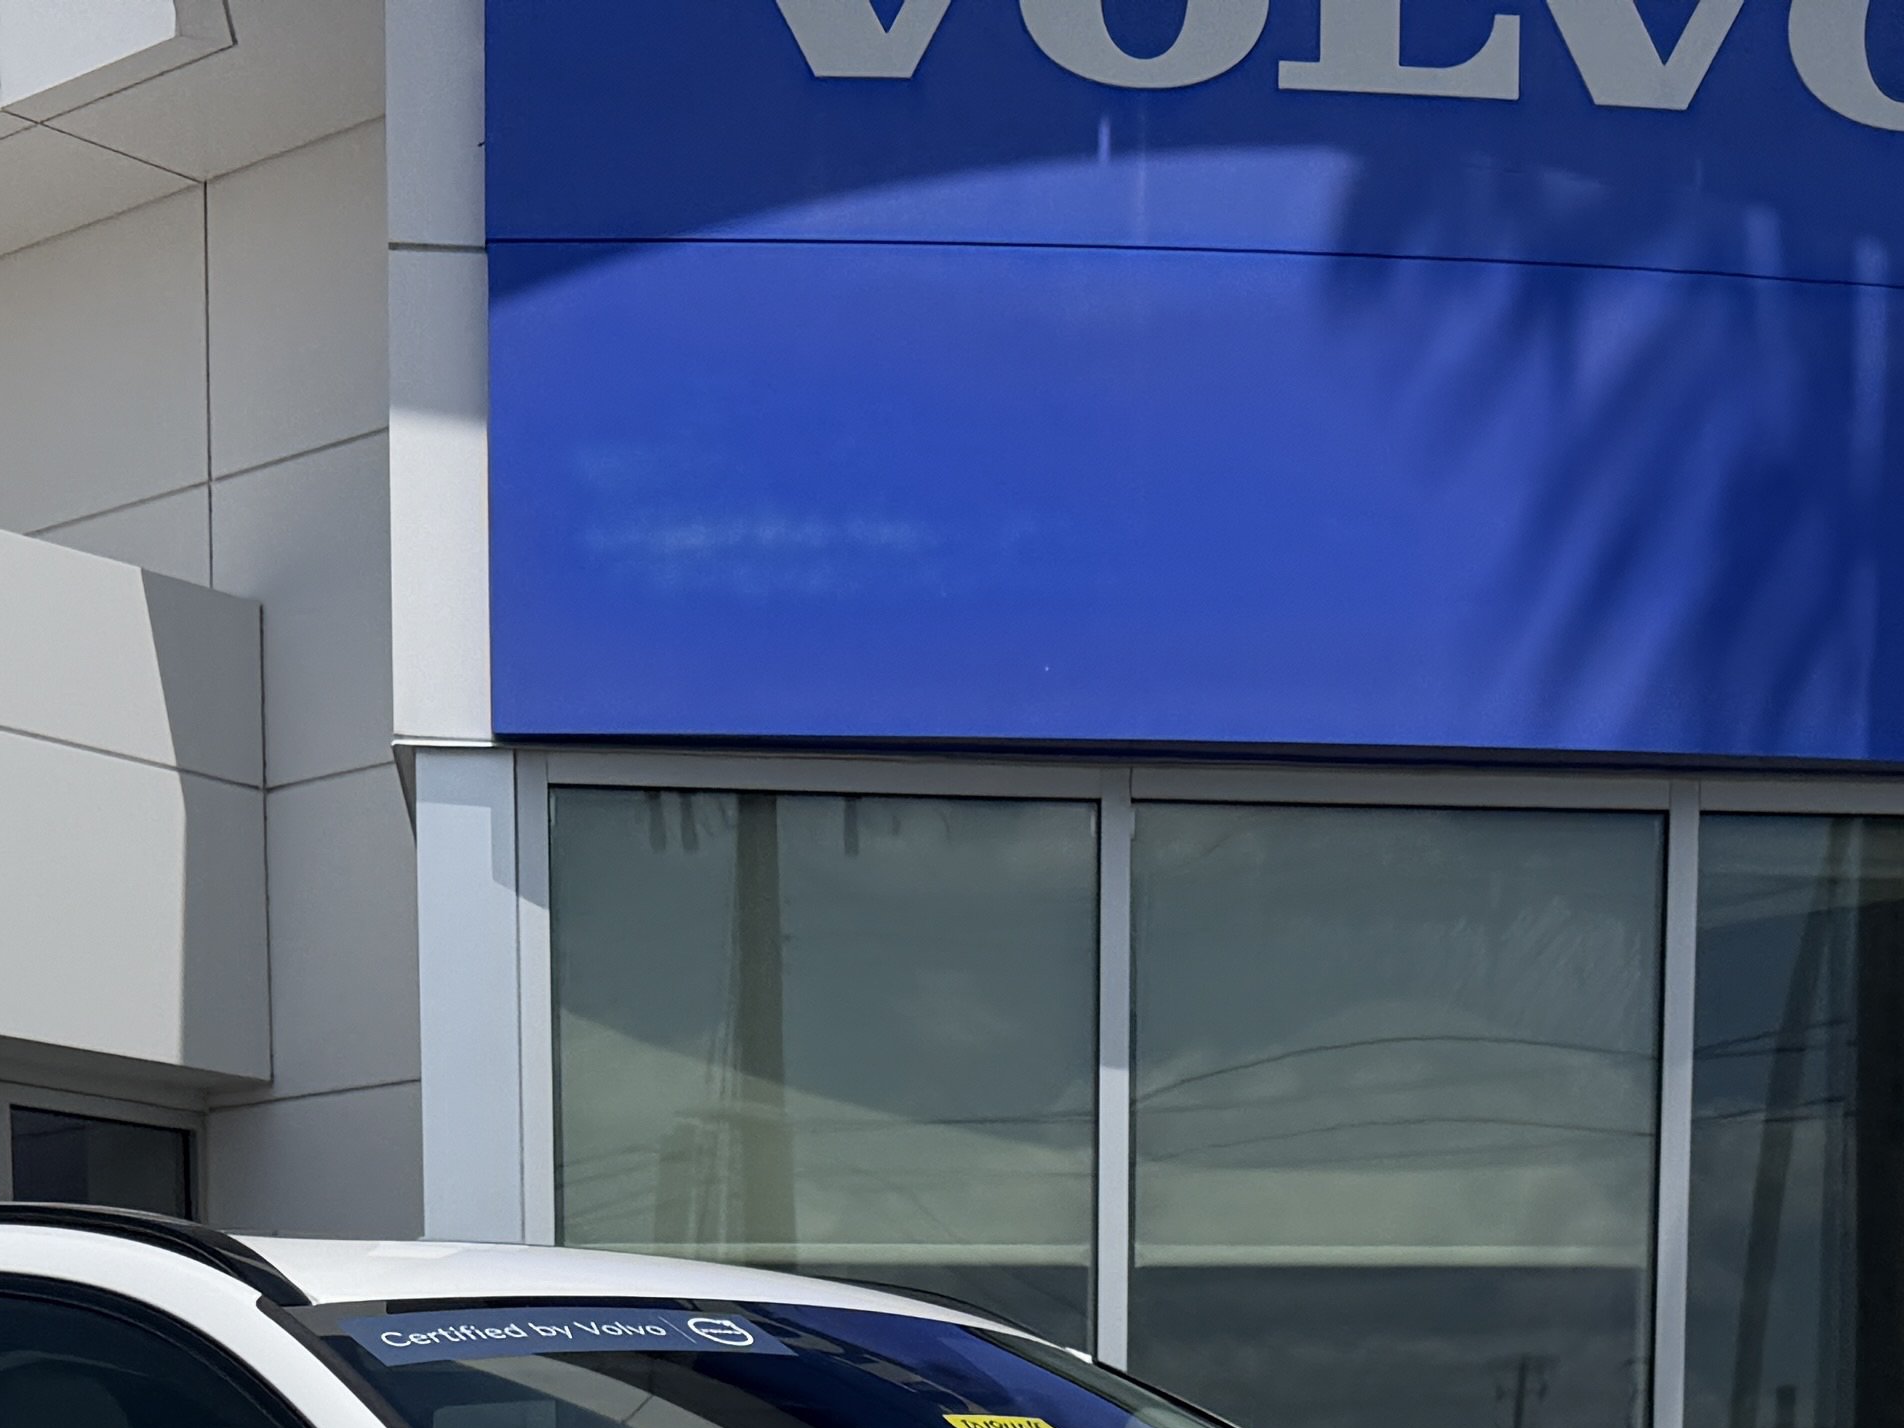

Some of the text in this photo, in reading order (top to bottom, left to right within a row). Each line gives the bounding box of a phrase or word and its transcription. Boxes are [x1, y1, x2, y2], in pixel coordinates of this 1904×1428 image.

[380, 1323, 528, 1347] Certified
[528, 1322, 573, 1339] by
[573, 1321, 667, 1336] Volvo
